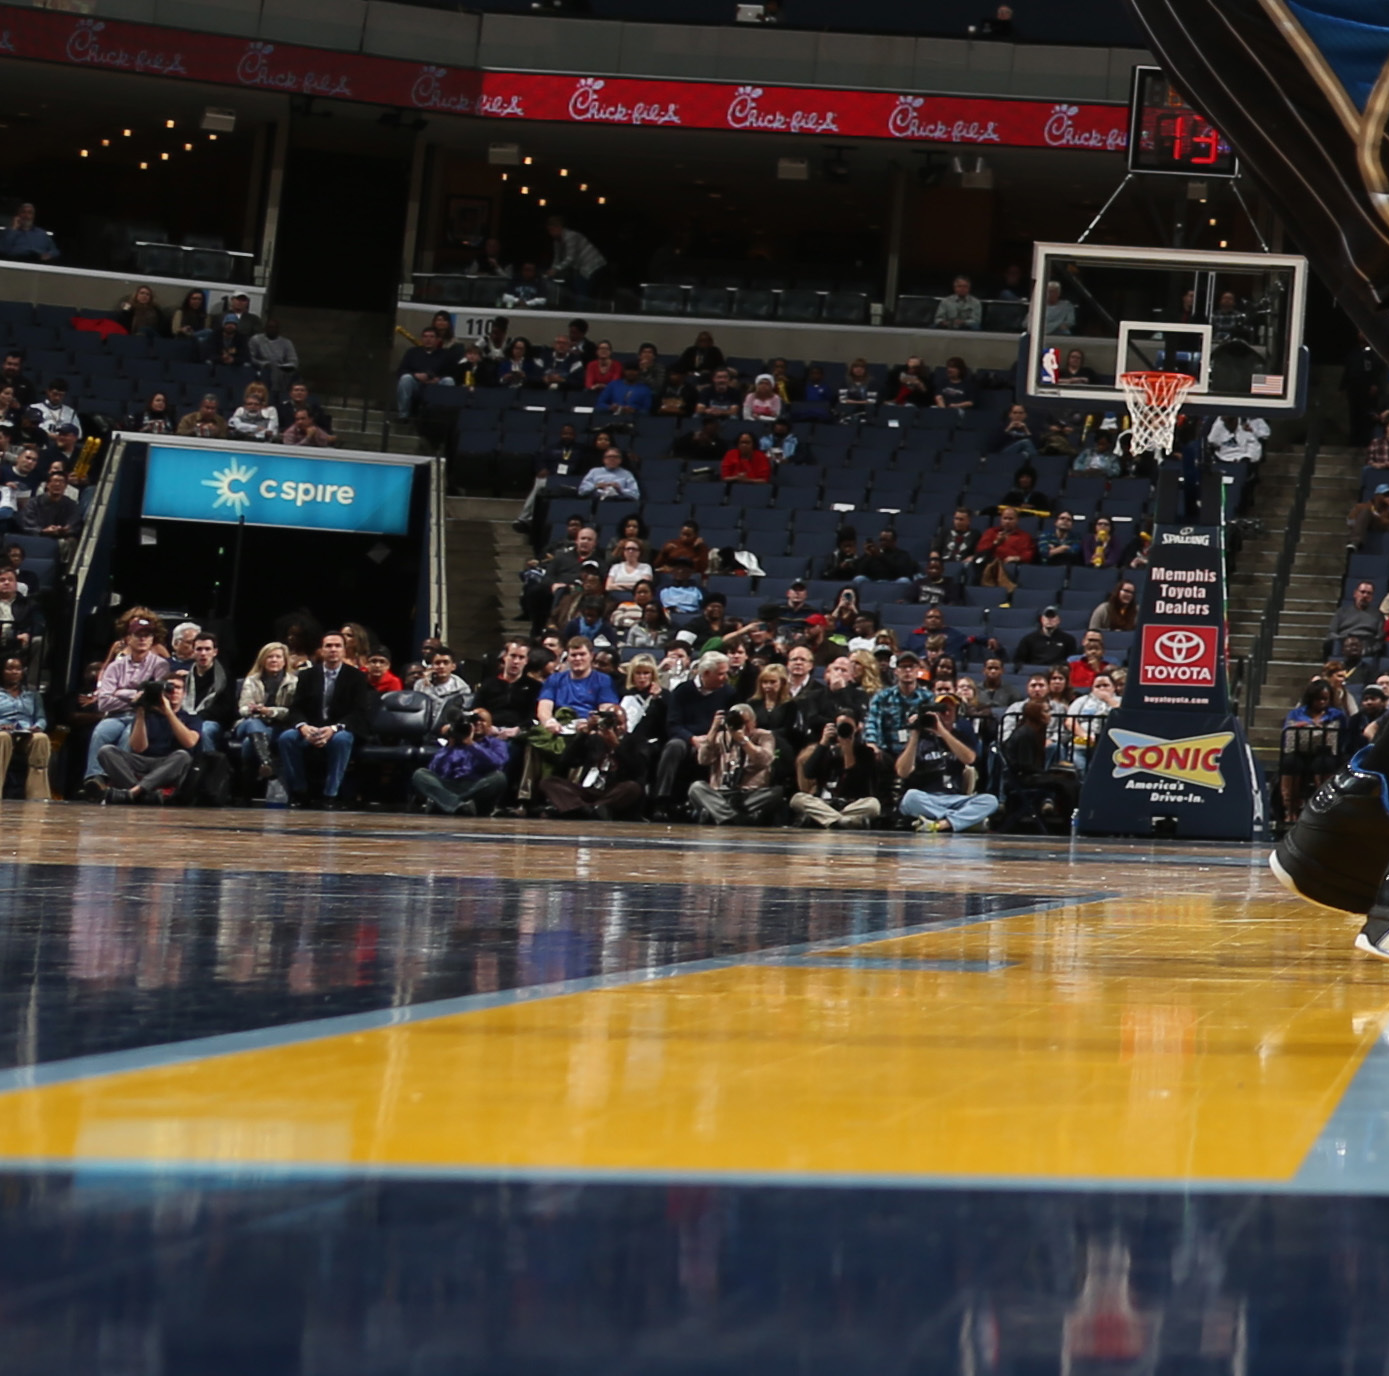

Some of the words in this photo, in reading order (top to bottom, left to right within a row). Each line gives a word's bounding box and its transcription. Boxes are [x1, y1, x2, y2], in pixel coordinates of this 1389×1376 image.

[1161, 532, 1210, 546] SPALDING
[1151, 567, 1217, 583] Memphis
[1160, 584, 1207, 599] Toyota
[1155, 600, 1210, 615] Dealers
[1144, 665, 1212, 681] TOYOTA
[1117, 745, 1223, 772] SONIC
[1125, 779, 1185, 791] America's
